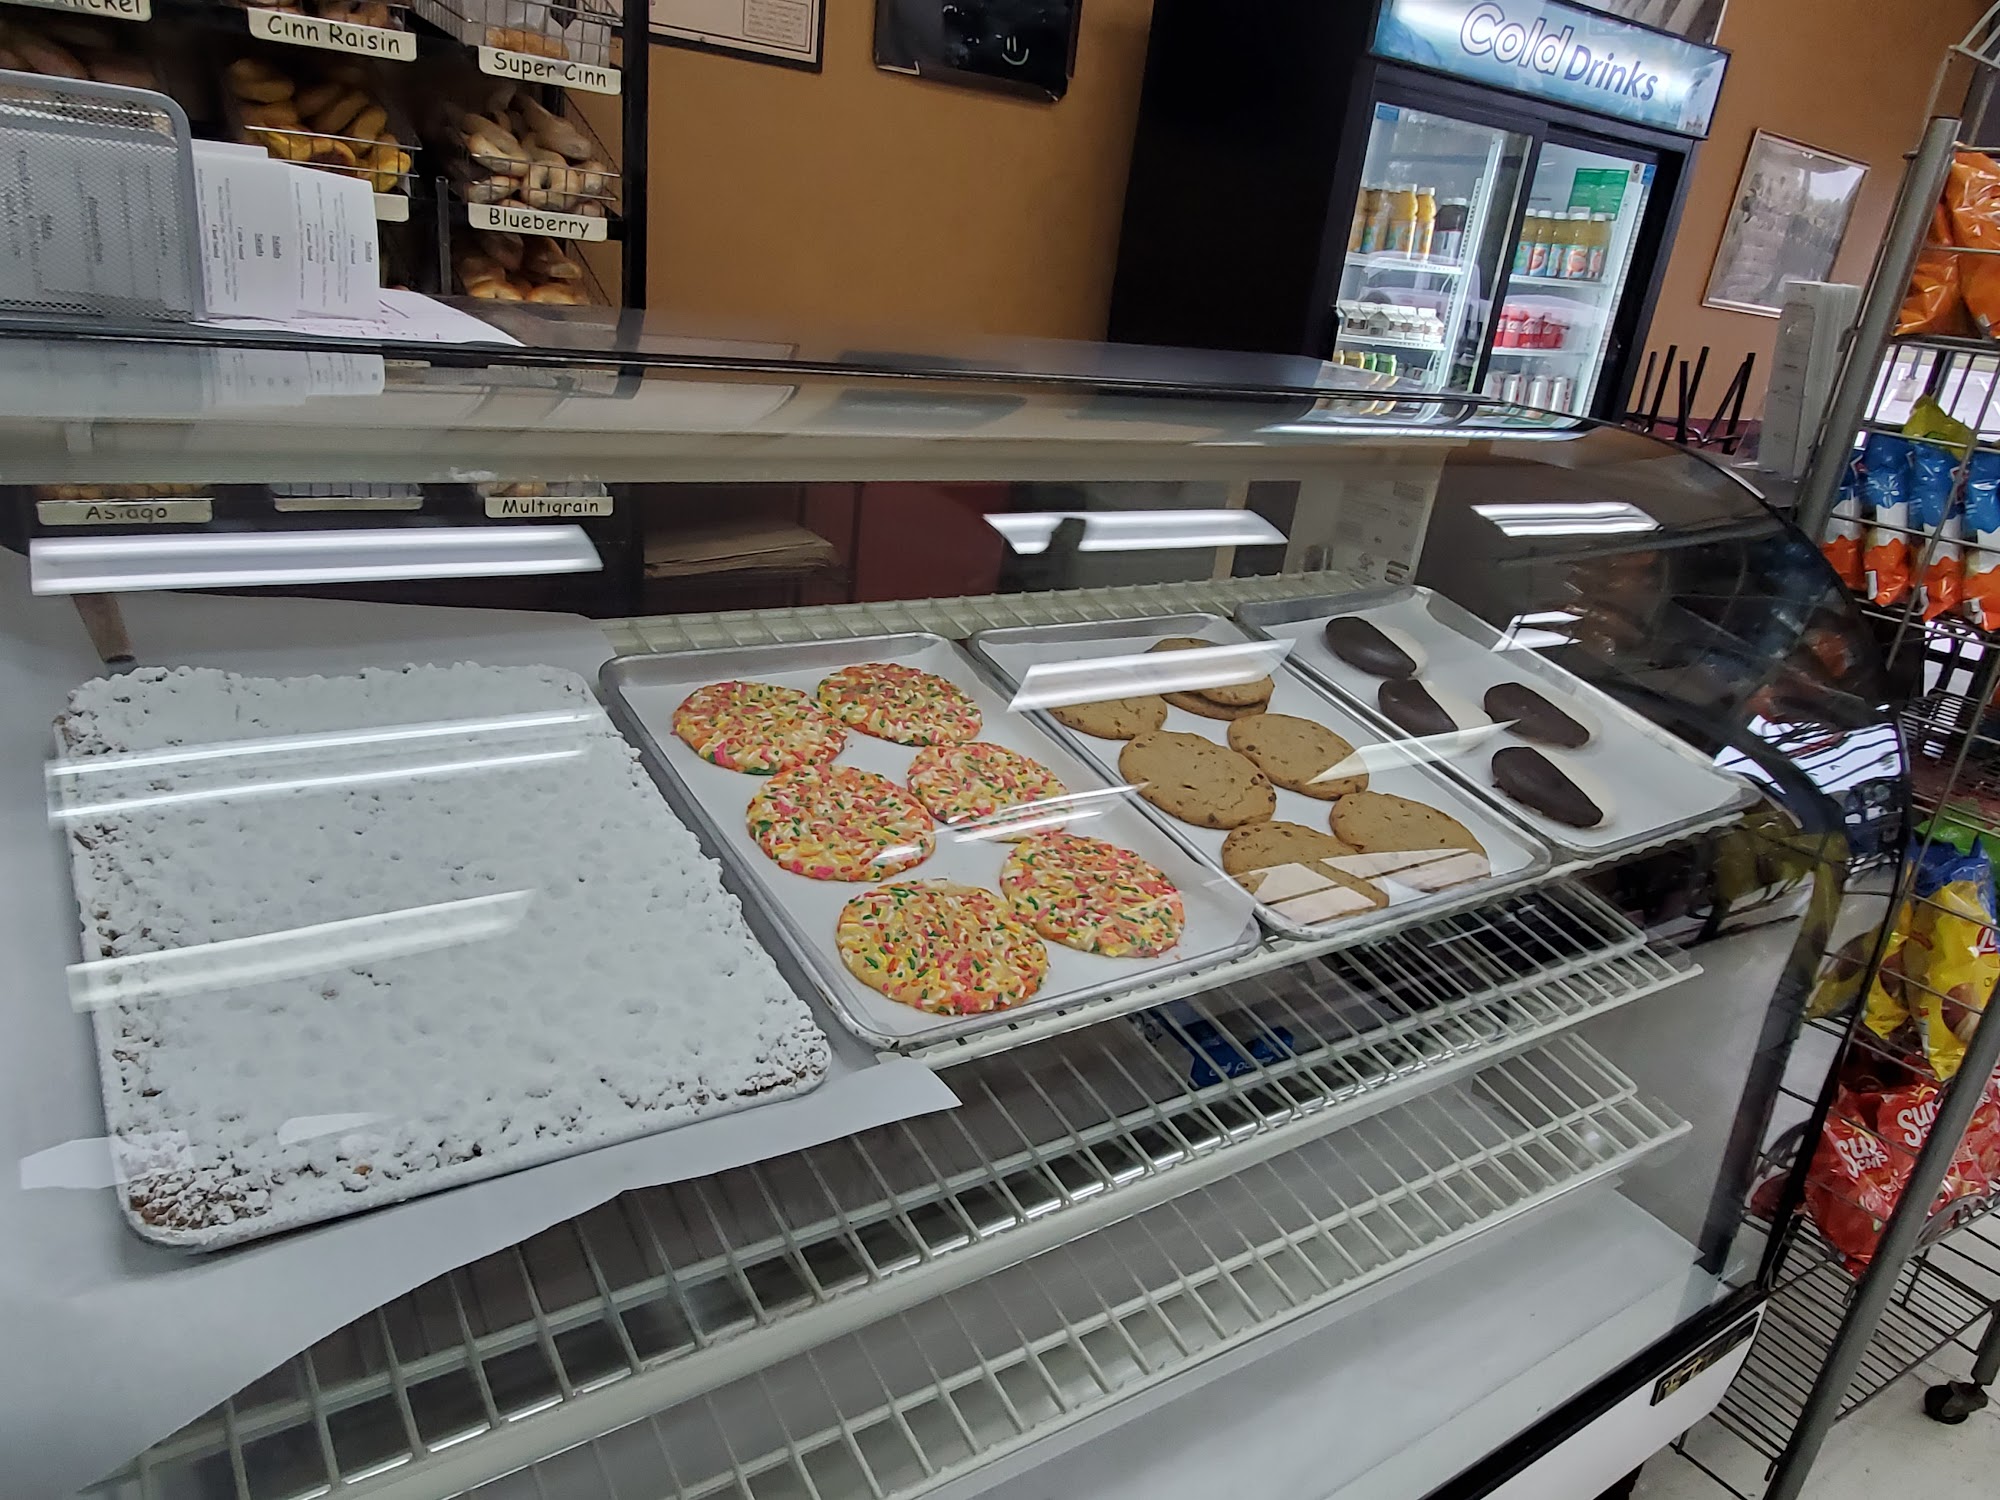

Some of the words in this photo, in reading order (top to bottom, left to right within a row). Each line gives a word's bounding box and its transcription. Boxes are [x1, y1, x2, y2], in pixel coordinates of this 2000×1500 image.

[267, 15, 319, 42] Cinn
[329, 23, 400, 54] Raisin
[1460, 1, 1575, 76] Cold
[1564, 44, 1659, 101] Drinks
[494, 51, 556, 79] Super
[564, 63, 607, 88] Cinn
[489, 207, 590, 239] Blueberry
[86, 506, 168, 522] Asiago
[502, 499, 599, 516] Multigrain
